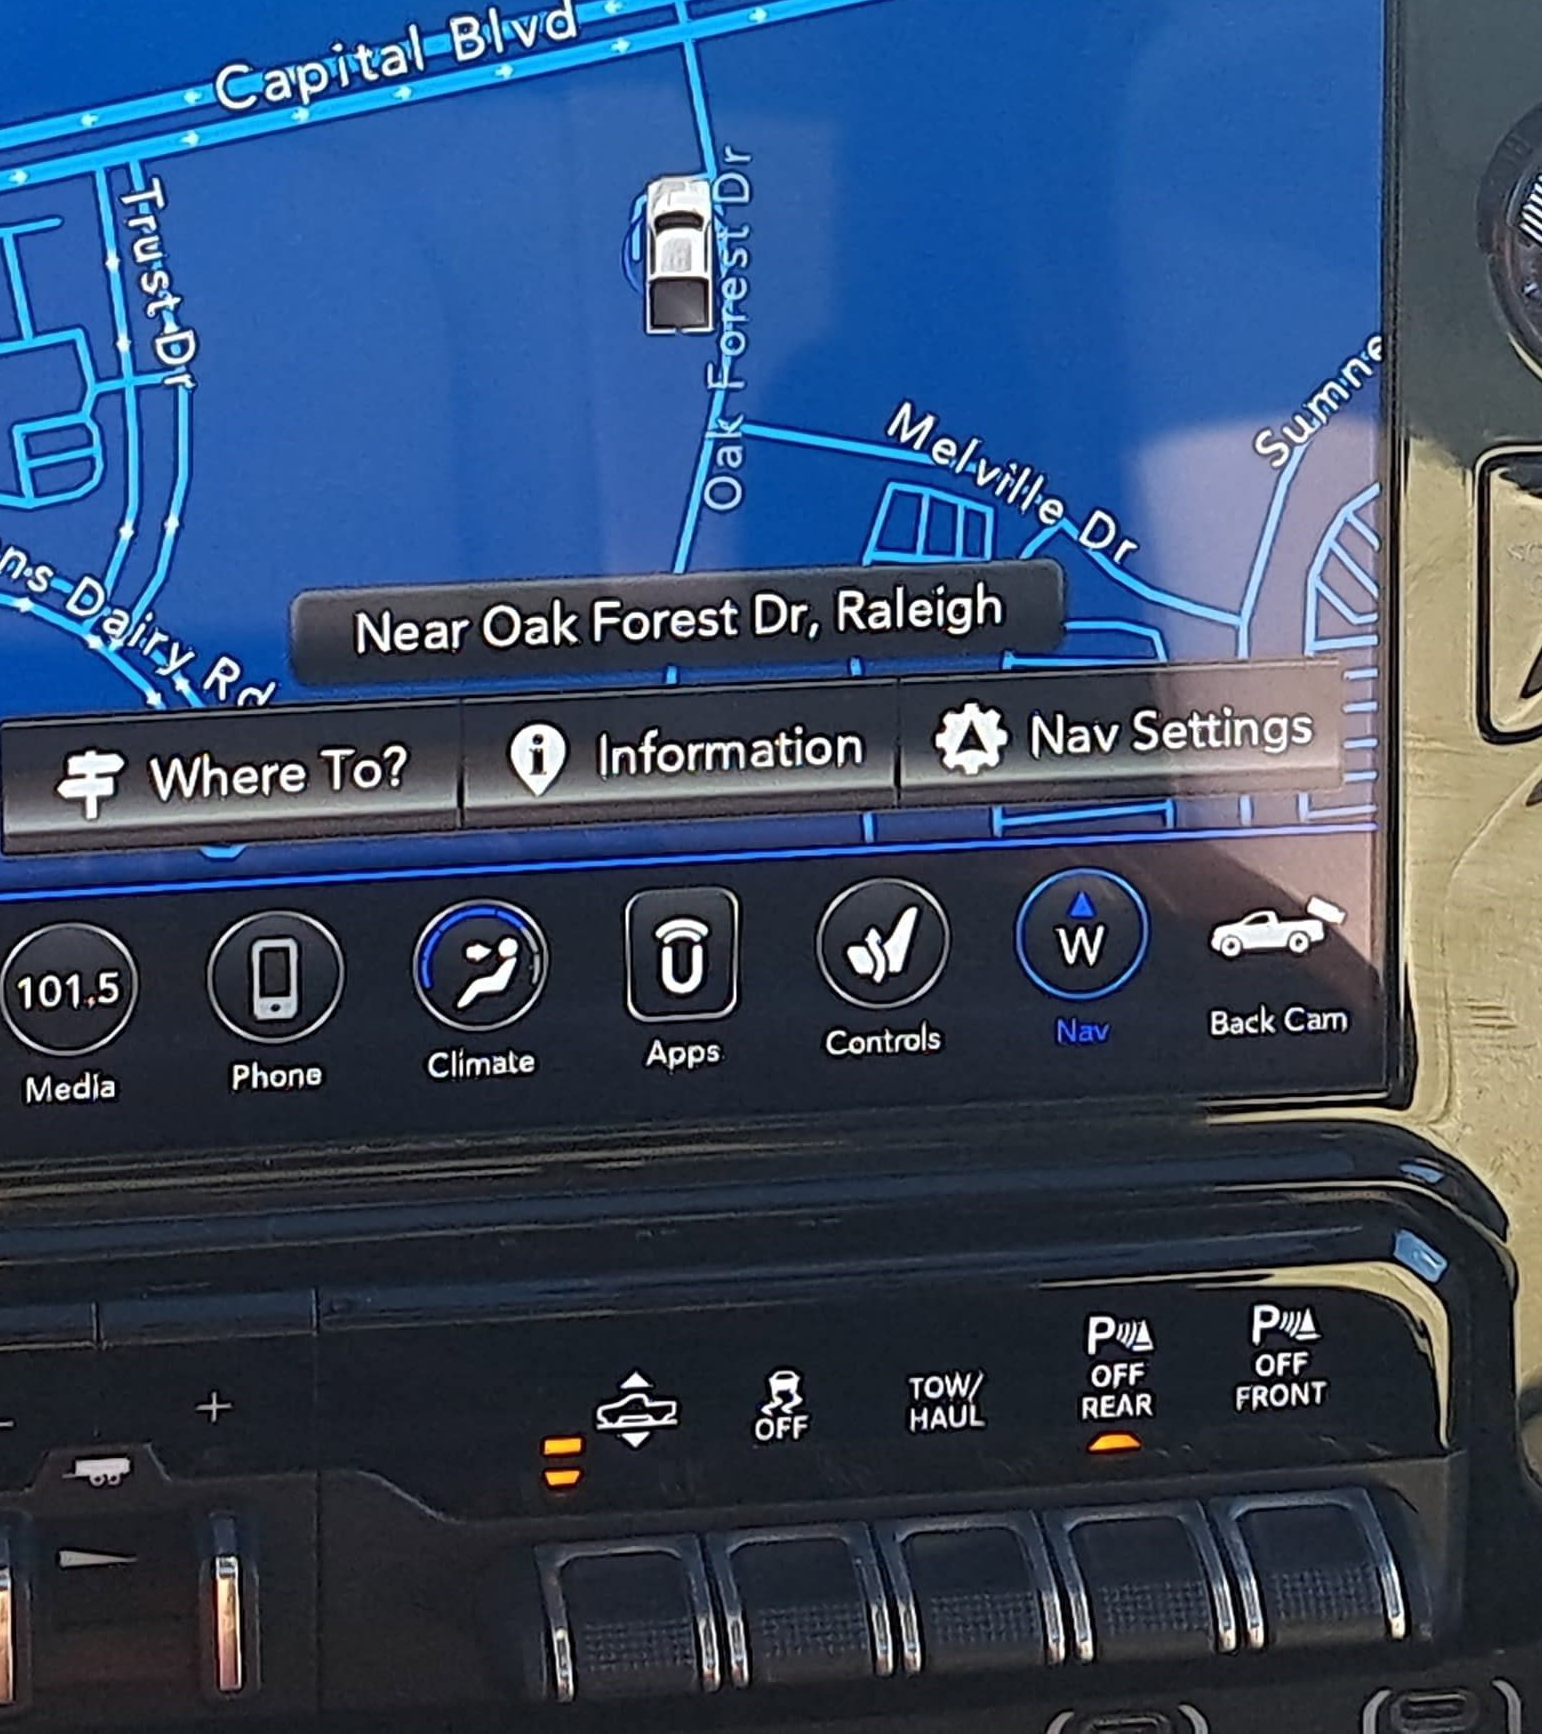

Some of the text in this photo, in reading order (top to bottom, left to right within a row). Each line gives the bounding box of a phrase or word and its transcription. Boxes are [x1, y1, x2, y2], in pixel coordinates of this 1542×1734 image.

[214, 24, 426, 113] Capital
[120, 177, 197, 389] Trust Dr
[703, 145, 753, 511] Oak Forest Dr
[886, 400, 1139, 565] Melville Dr
[65, 574, 196, 677] Dairy
[356, 584, 1003, 655] Near Oak Forest Dr, Raleigh
[1030, 707, 1315, 760] Nav Settings
[600, 728, 863, 777] Information
[150, 745, 409, 803] Where To?
[1058, 925, 1106, 967] W
[16, 970, 120, 1011] 101.5
[1057, 1018, 1111, 1044] Nav
[1210, 1007, 1349, 1037] Back Cam
[646, 1039, 722, 1071] Apps
[825, 1022, 942, 1057] Controls
[231, 1063, 323, 1092] Phone
[427, 1050, 536, 1080] Climate
[25, 1073, 116, 1104] Media
[1091, 1362, 1146, 1388] OFF
[1255, 1351, 1309, 1377] OFF
[908, 1370, 986, 1403] TOW/
[1235, 1379, 1327, 1411] FRONT
[909, 1403, 986, 1432] HAUL
[1081, 1391, 1153, 1418] REAR
[754, 1415, 808, 1442] OFF
